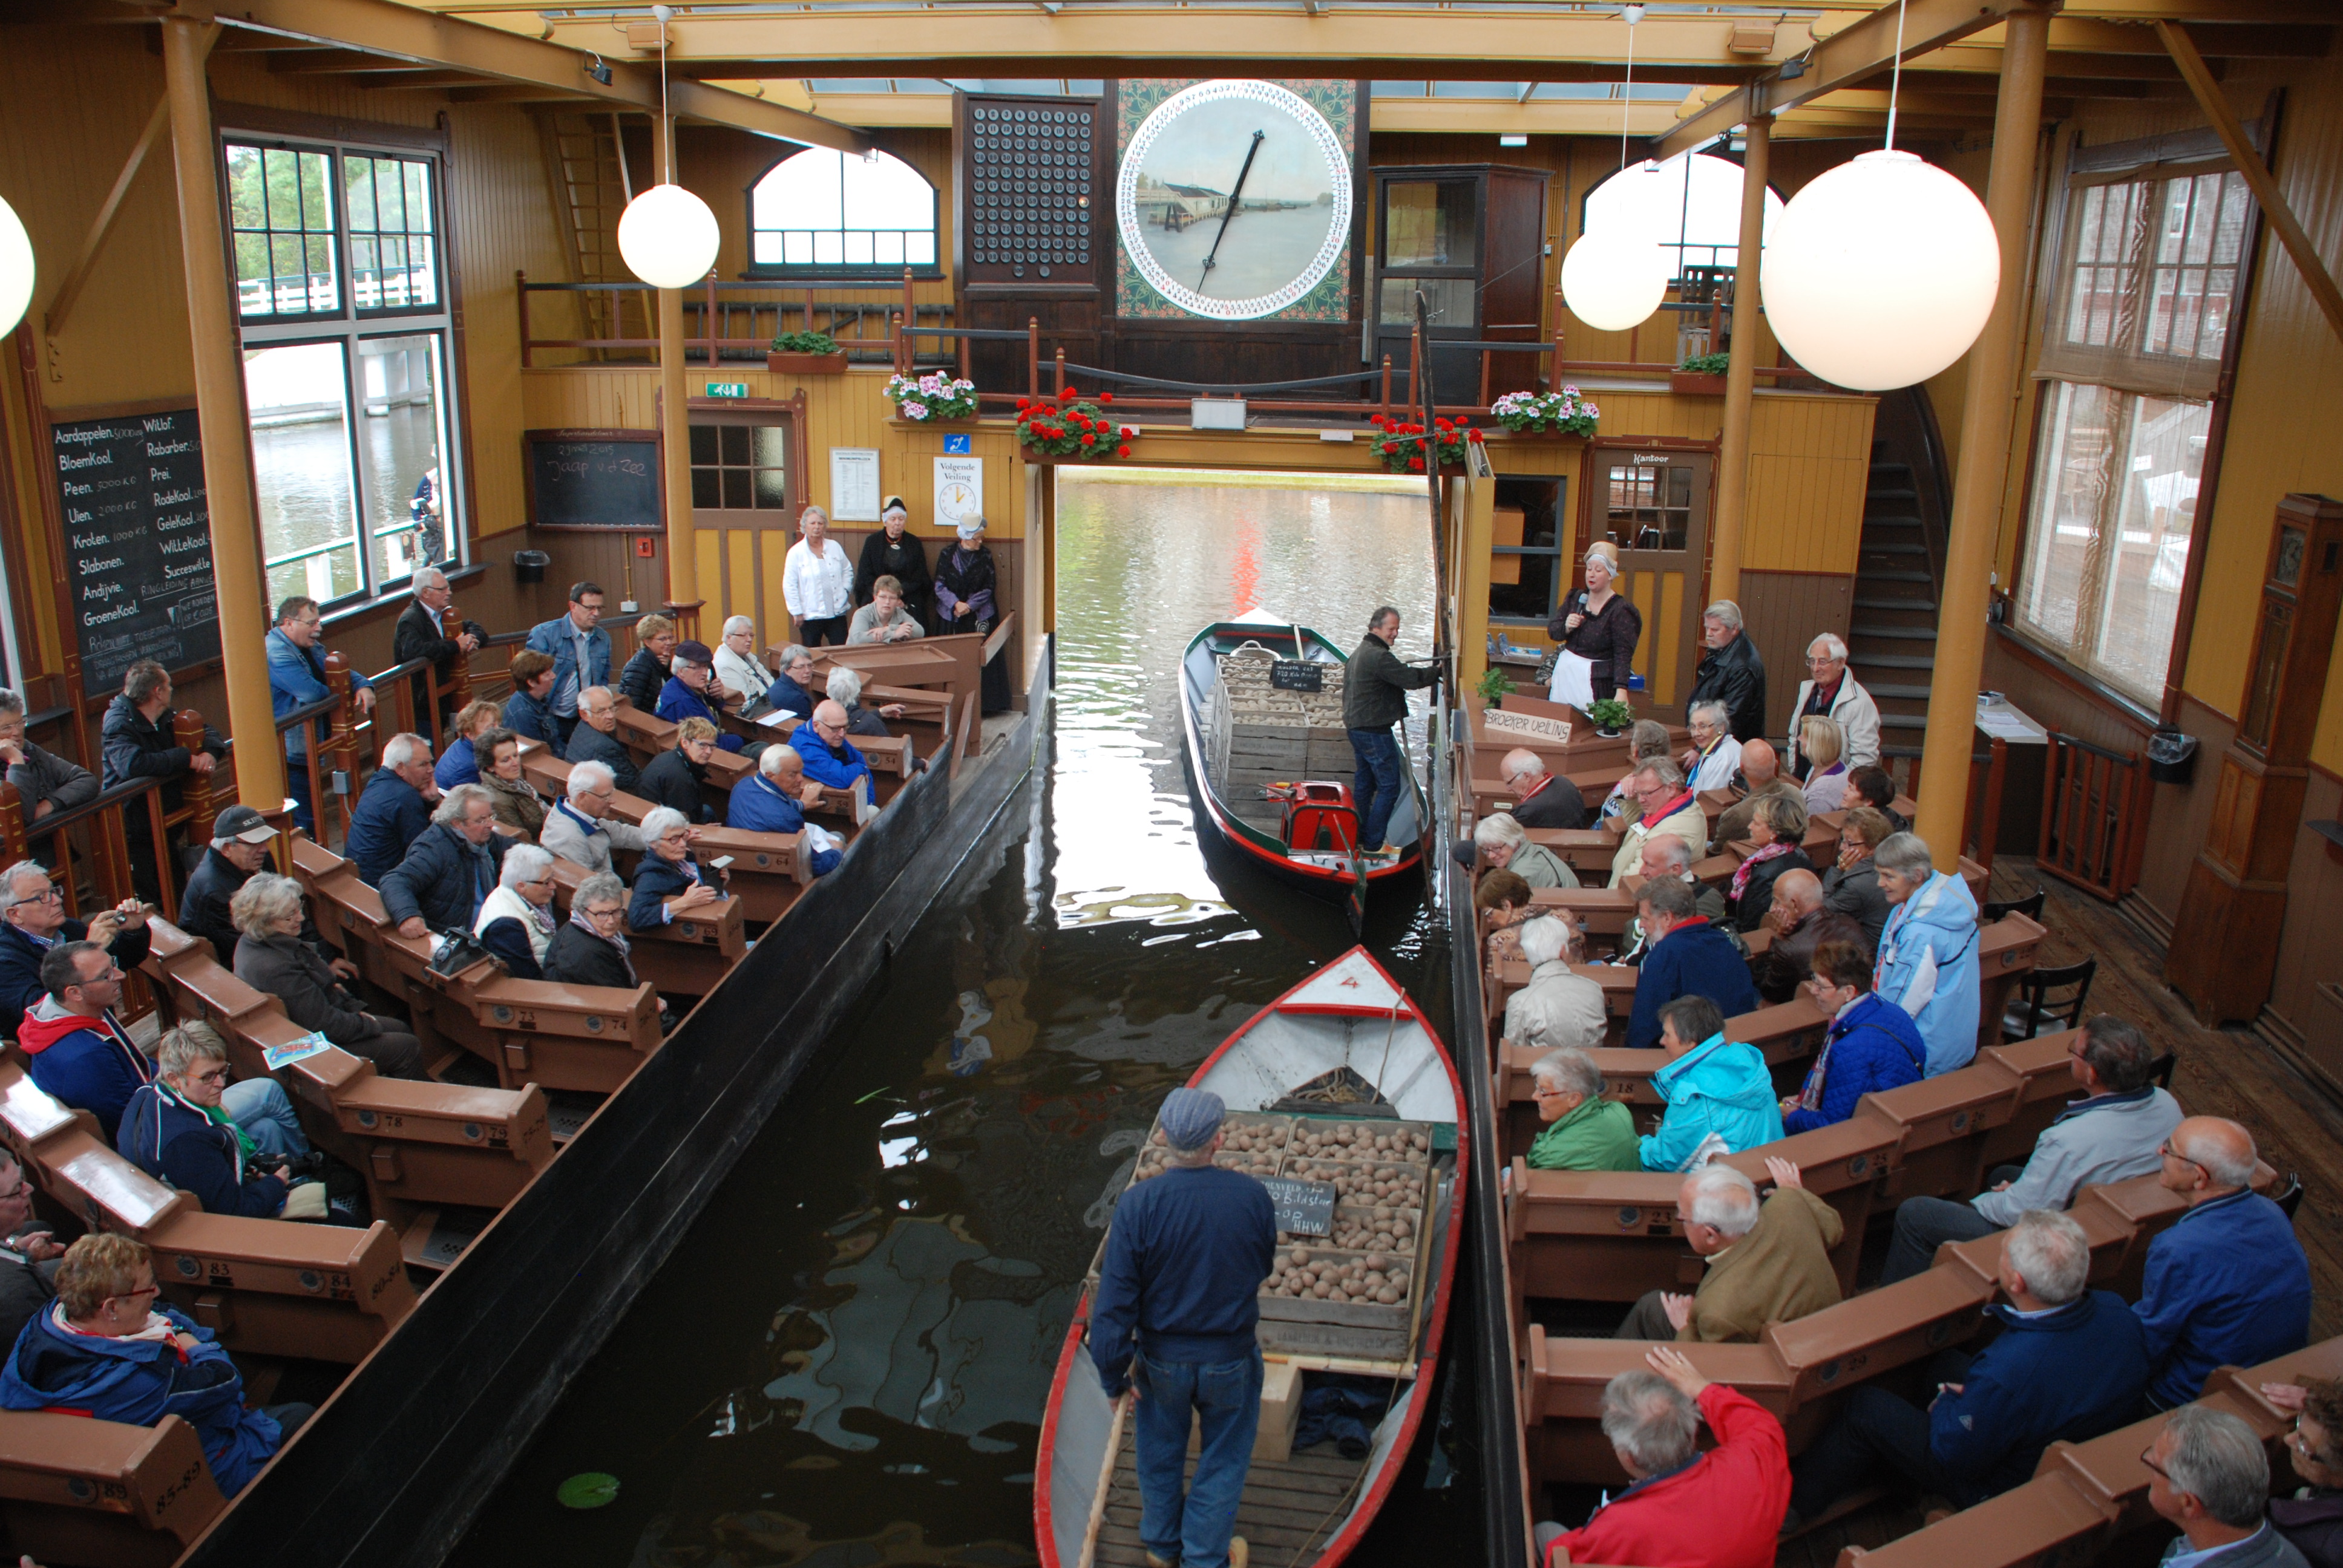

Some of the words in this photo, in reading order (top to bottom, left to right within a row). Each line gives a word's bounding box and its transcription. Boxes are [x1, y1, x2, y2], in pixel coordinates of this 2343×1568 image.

[1634, 454, 1669, 465] Kantoor
[546, 460, 588, 481] Jaap
[620, 459, 646, 476] Zee
[940, 463, 975, 472] Volgende
[945, 472, 971, 482] Veiling
[776, 857, 789, 866] 64
[704, 927, 718, 937] 69
[1340, 976, 1358, 988] 4
[520, 1011, 535, 1021] 73
[612, 1019, 627, 1031] 74
[1617, 1083, 1633, 1094] 18
[385, 1116, 402, 1128] 78
[490, 1127, 507, 1138] 79
[1293, 1220, 1325, 1233] HHW
[210, 1263, 230, 1275] 83
[332, 1275, 351, 1289] 84
[104, 1483, 128, 1499] 89
[157, 1460, 200, 1514] 85-89
